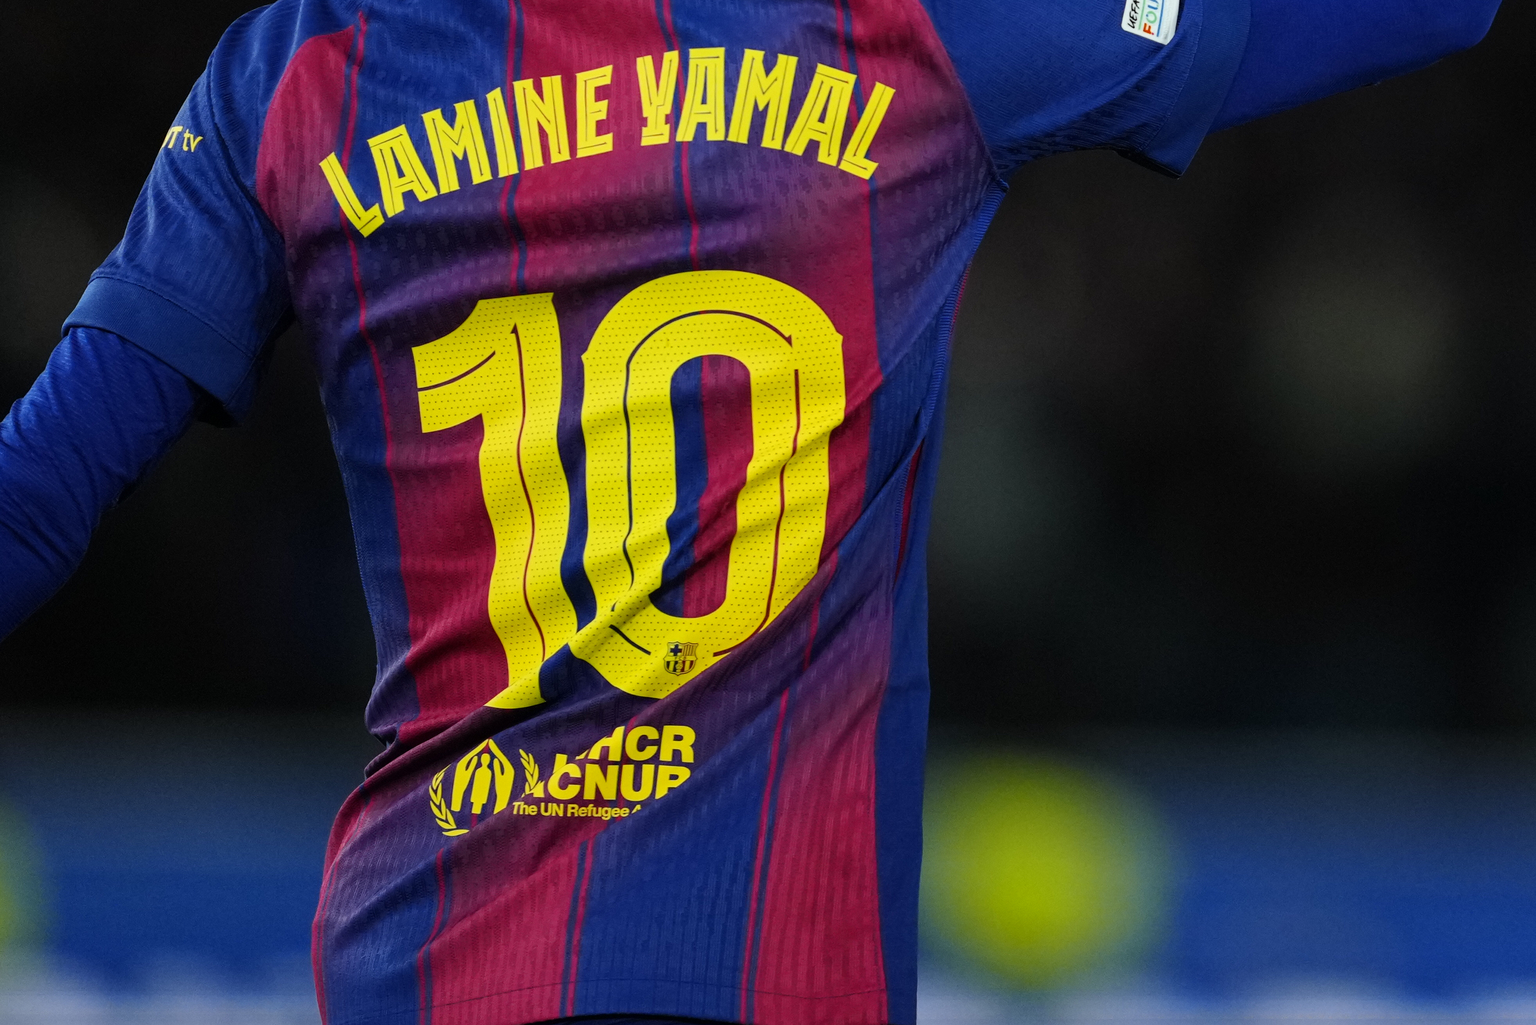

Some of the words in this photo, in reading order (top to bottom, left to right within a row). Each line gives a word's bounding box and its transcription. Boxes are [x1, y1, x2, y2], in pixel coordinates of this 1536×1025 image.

[1127, 0, 1140, 29] UEFA
[182, 128, 204, 153] tv
[319, 64, 615, 238] LAMINE
[637, 47, 897, 181] YAMAL
[411, 269, 846, 710] 10
[512, 801, 538, 816] The
[540, 802, 564, 817] UN
[566, 804, 630, 821] Refugee
